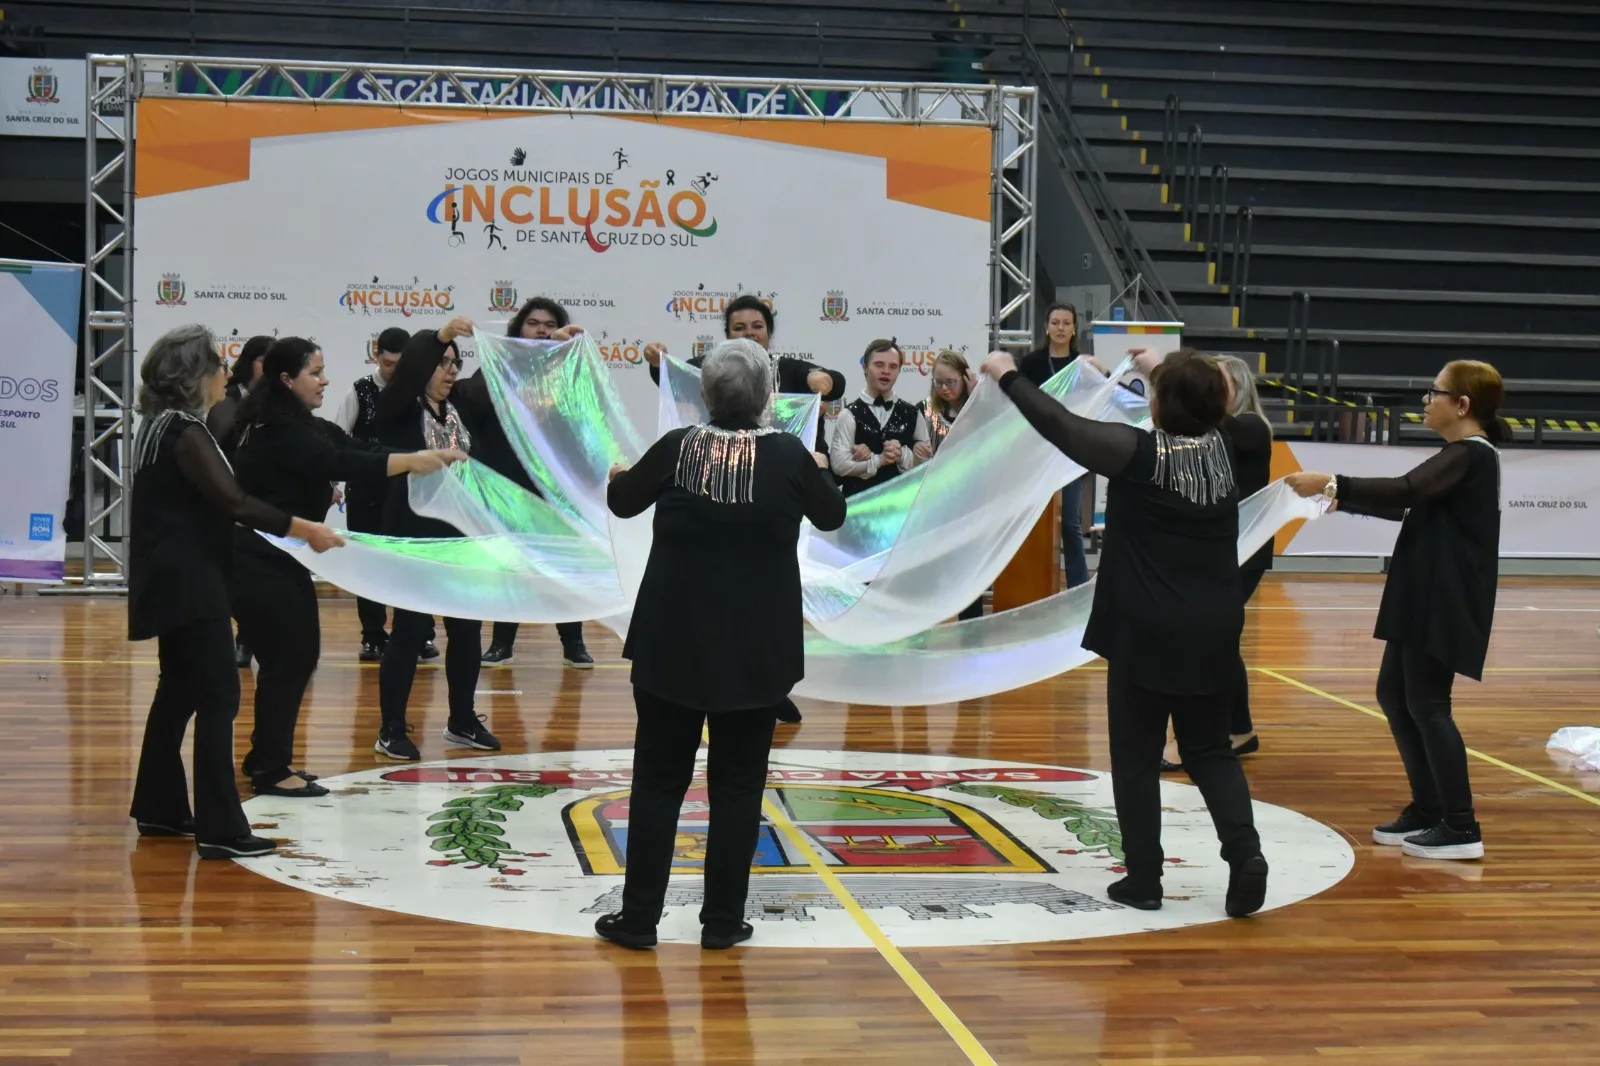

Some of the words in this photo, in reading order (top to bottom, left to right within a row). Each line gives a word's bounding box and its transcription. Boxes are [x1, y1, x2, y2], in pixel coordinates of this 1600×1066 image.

[357, 77, 553, 107] SECRETARIA
[561, 85, 738, 113] MUNIIPA
[747, 92, 787, 115] DE
[445, 168, 499, 181] JOGOS
[503, 170, 590, 184] MUNICIPAIS
[594, 172, 614, 185] DE
[444, 179, 707, 229] INCLUSÃO
[516, 230, 536, 242] DE
[541, 231, 590, 244] SANTA
[597, 232, 639, 246] CRUZ
[642, 233, 665, 246] DO
[670, 234, 698, 247] SUL
[194, 290, 225, 299] SANTA
[227, 291, 251, 300] CRUZ
[253, 292, 267, 300] DO
[270, 293, 287, 301] SUL
[346, 287, 451, 307] INCLUSÃO
[558, 298, 581, 306] CRUZ
[583, 299, 597, 307] DO
[599, 299, 616, 307] SUL
[856, 307, 885, 315] SANTA
[887, 308, 909, 316] CRUZ
[911, 308, 925, 316] DO
[927, 308, 943, 316] SUL
[461, 350, 474, 358] DO
[0, 420, 16, 428] SUL
[1508, 500, 1535, 508] SANTA
[1573, 501, 1588, 509] SUL
[848, 771, 1041, 780] SANTA
